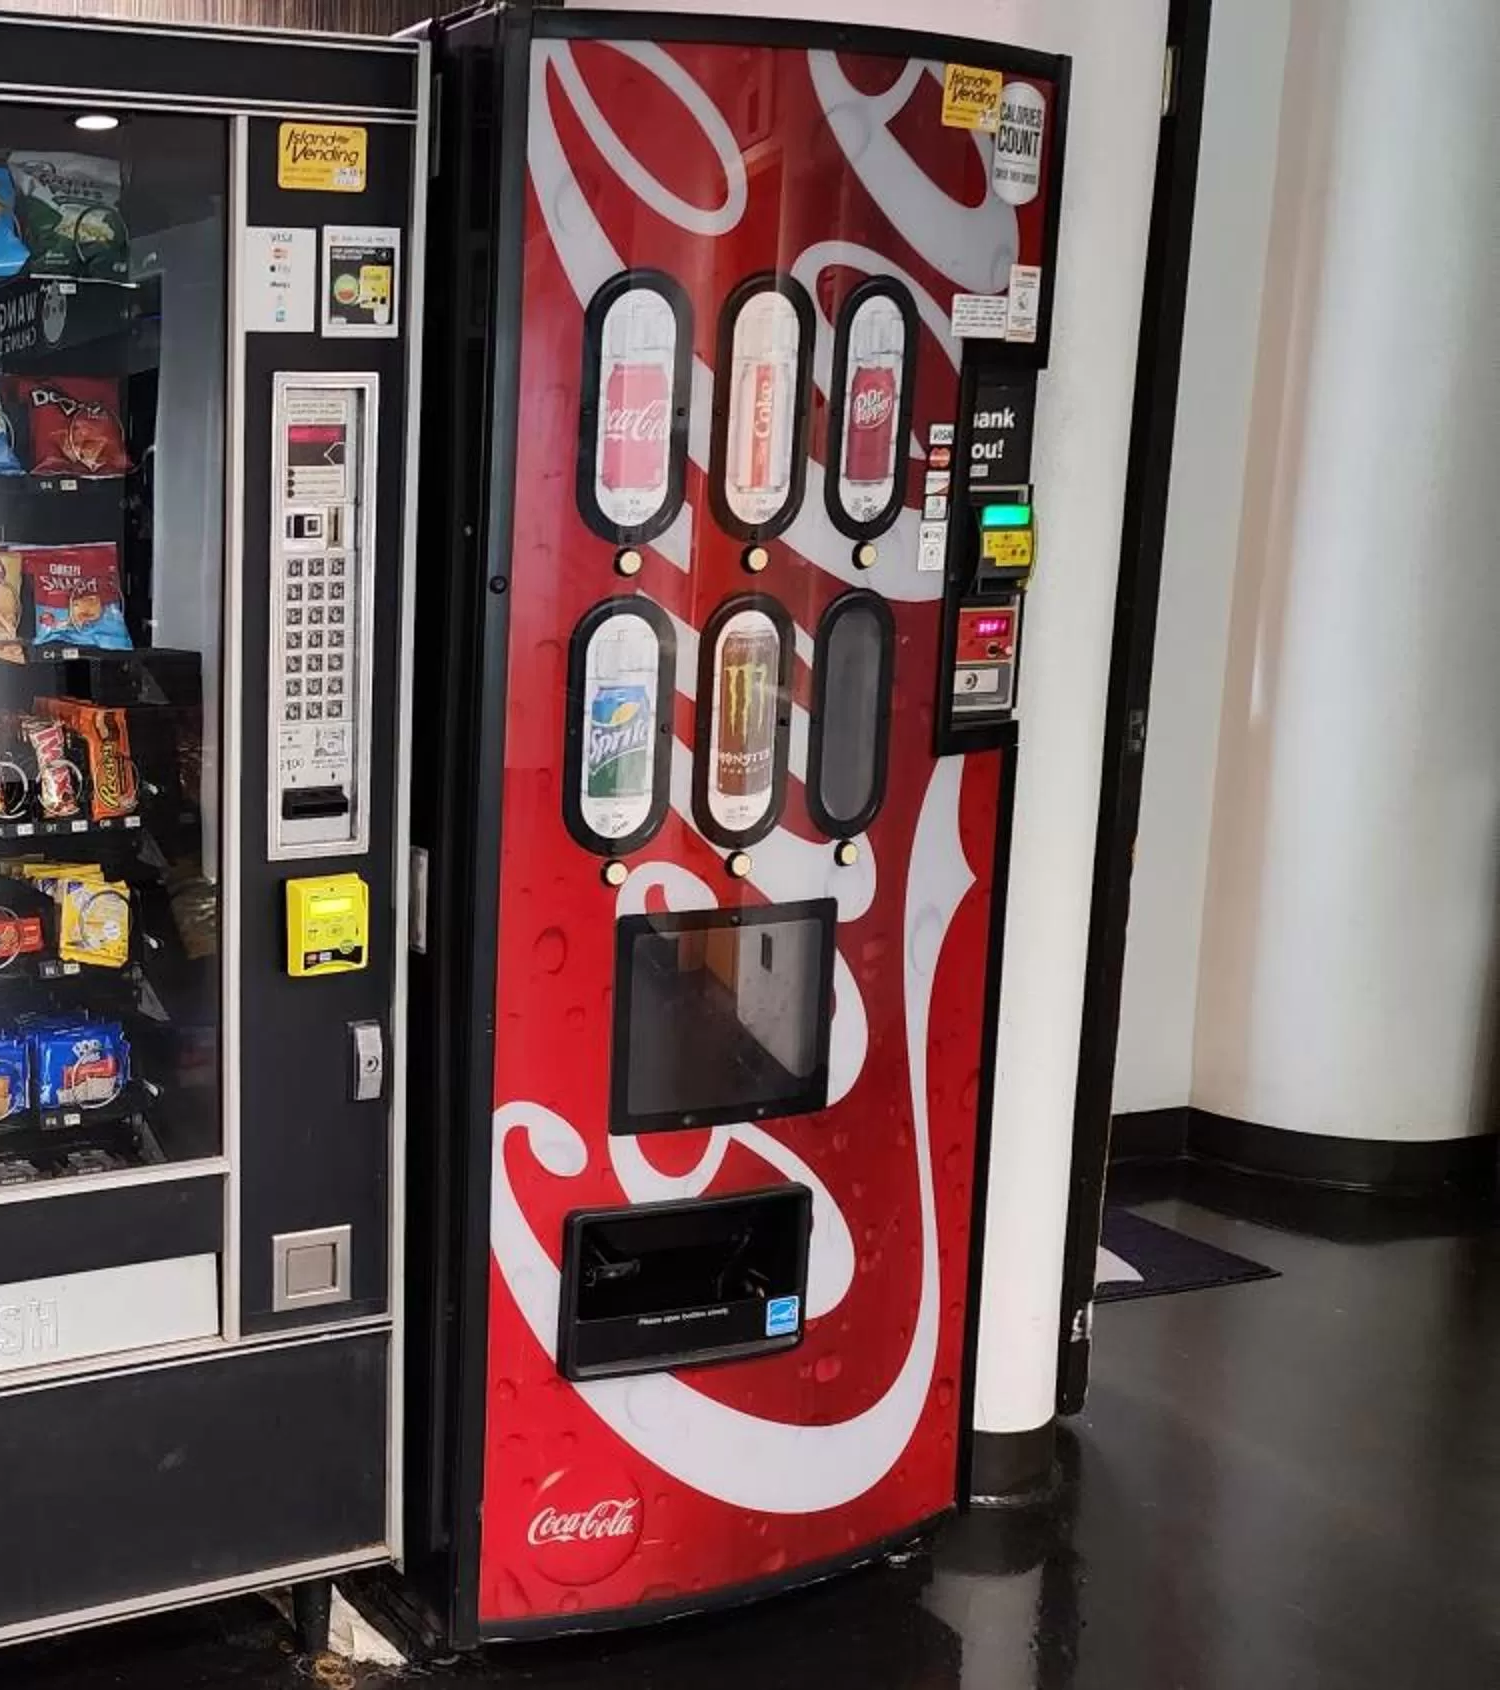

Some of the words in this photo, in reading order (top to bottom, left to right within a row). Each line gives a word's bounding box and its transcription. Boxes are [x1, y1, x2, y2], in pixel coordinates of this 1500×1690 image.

[950, 85, 998, 111] Vending
[1000, 101, 1043, 129] CALORIES
[285, 130, 337, 152] Island
[997, 125, 1041, 158] COUNT
[291, 145, 361, 167] Vending
[754, 381, 774, 438] Coke
[971, 438, 1004, 460] ou!
[588, 719, 648, 764] Sprite
[718, 749, 772, 766] MONSTER
[527, 1496, 640, 1547] Coca-Cola
